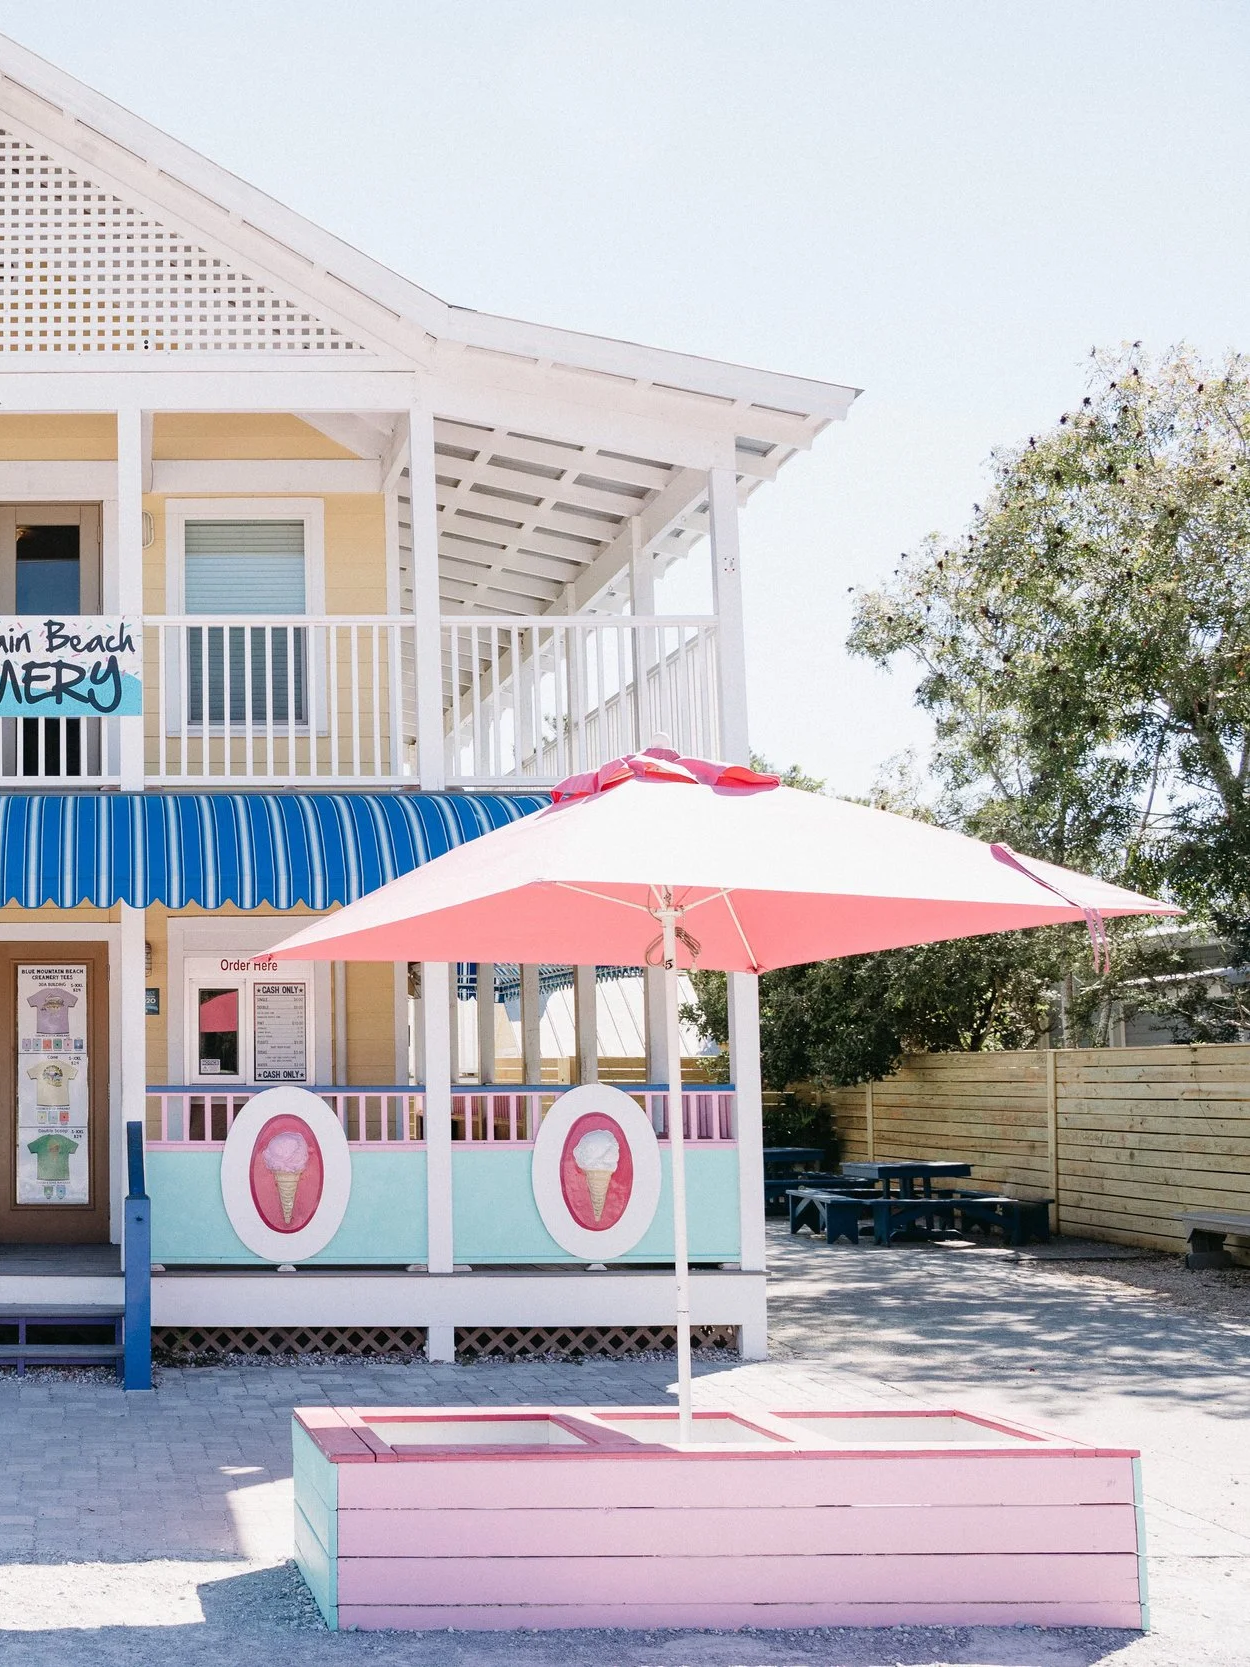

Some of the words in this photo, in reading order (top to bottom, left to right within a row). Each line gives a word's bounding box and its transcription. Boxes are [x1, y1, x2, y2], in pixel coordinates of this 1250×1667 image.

[44, 619, 136, 654] Beach
[220, 959, 250, 970] Order
[254, 962, 278, 971] Here
